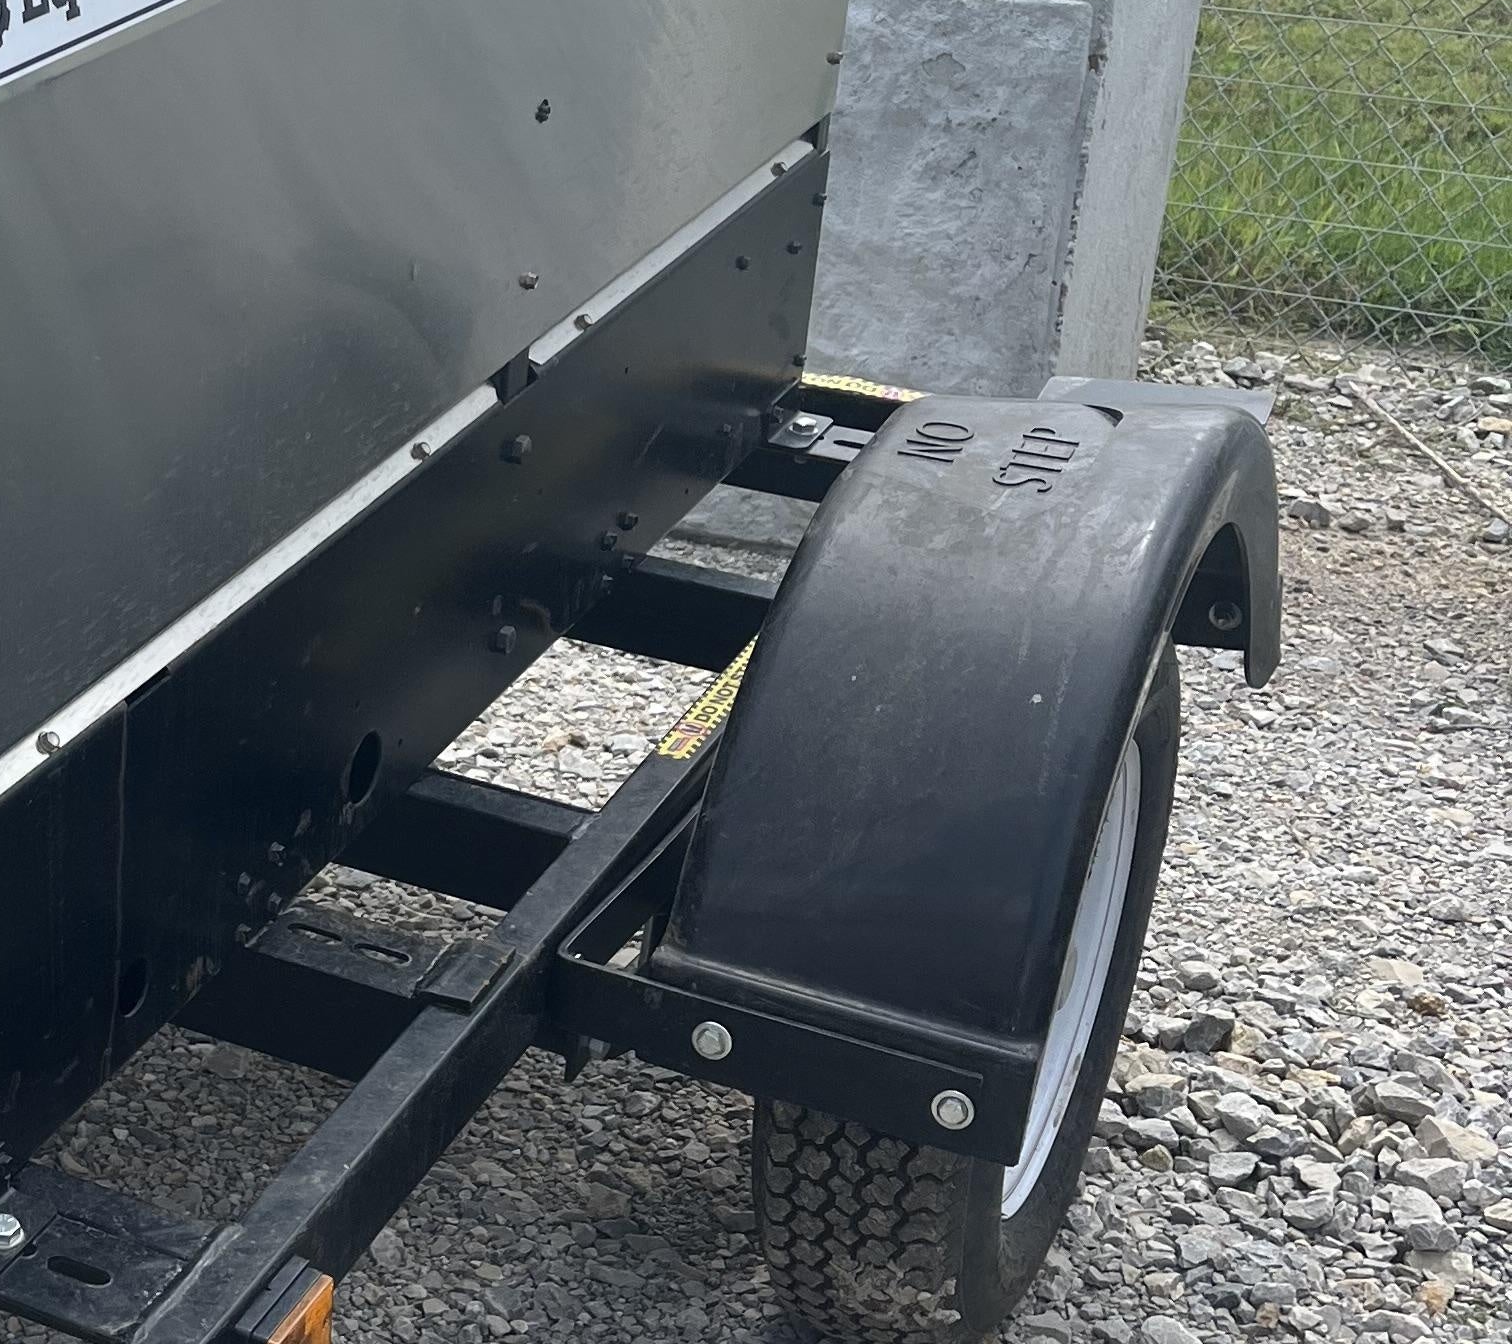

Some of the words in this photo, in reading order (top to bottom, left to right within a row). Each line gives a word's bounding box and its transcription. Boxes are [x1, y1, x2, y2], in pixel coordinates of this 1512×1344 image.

[897, 422, 975, 464] NO
[992, 427, 1080, 493] STEP
[694, 705, 719, 723] DO
[709, 681, 739, 706] NOT
